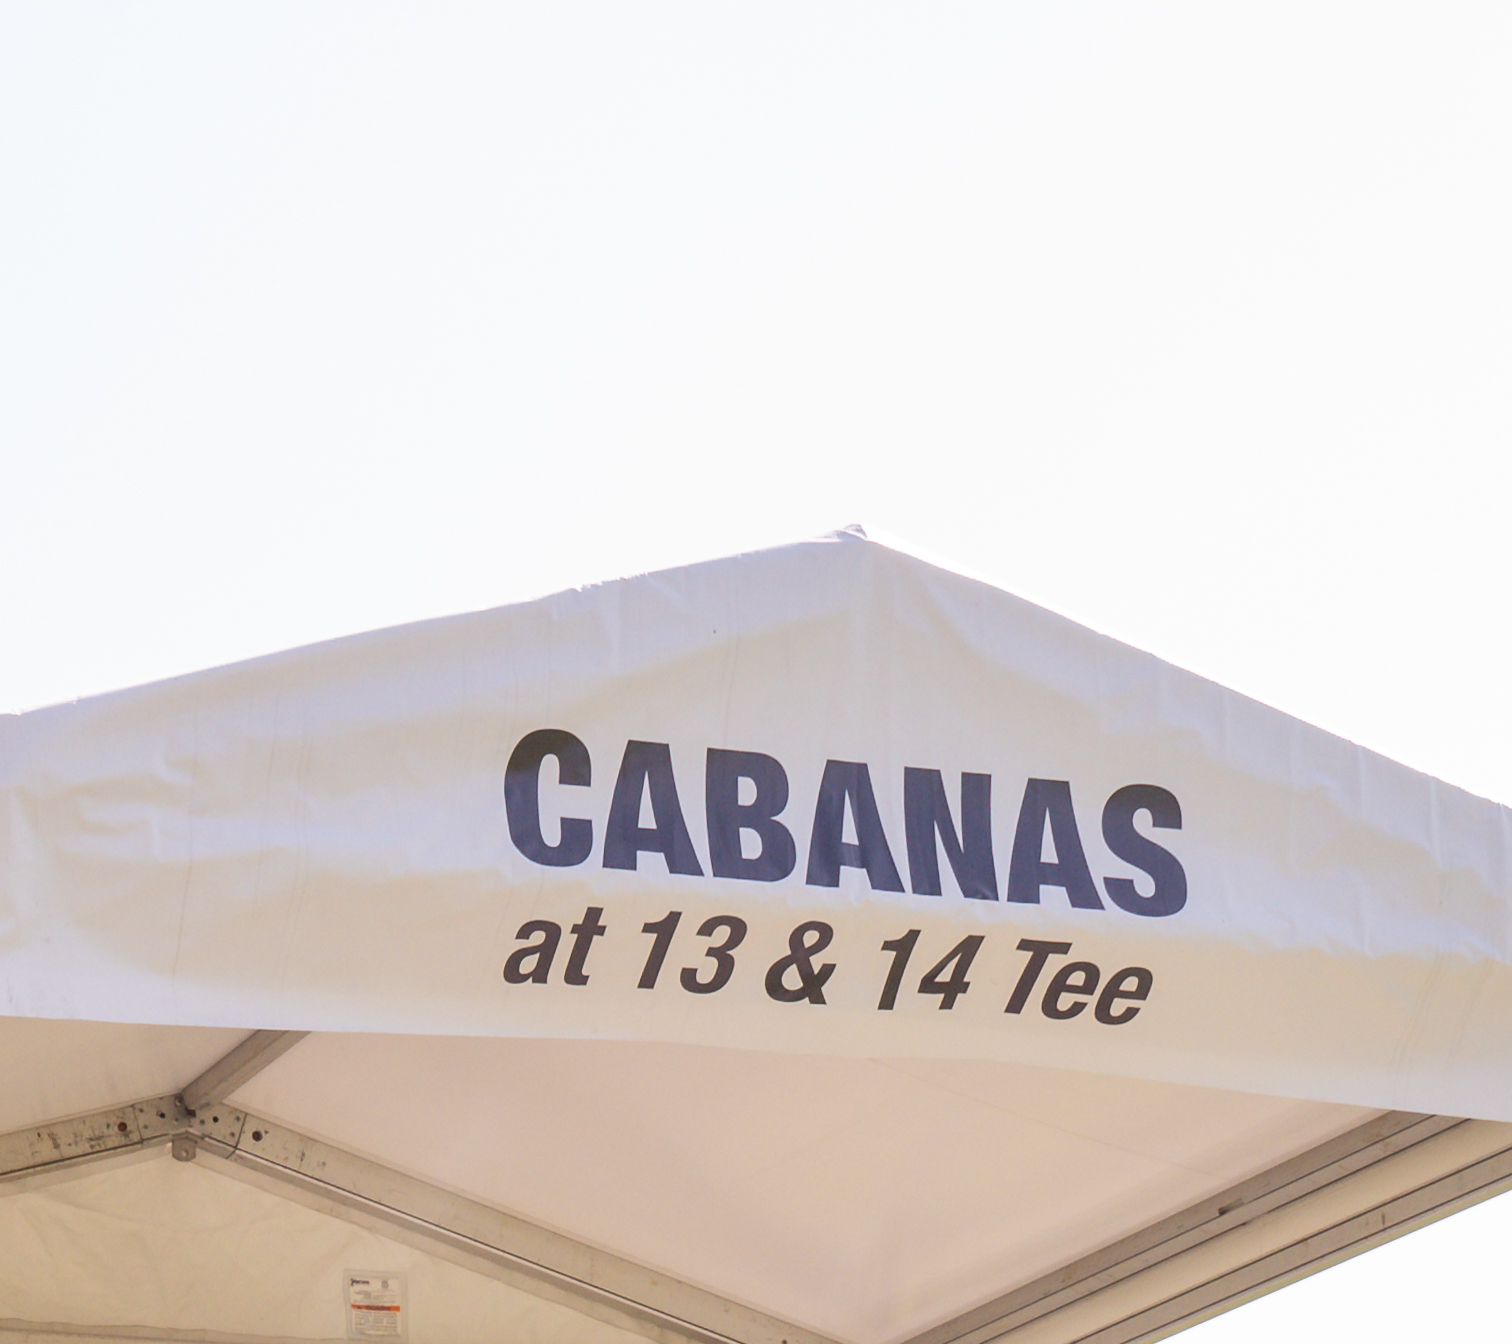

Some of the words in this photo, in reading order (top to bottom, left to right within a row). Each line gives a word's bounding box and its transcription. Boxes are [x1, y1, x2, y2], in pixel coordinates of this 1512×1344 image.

[504, 729, 1187, 919] CABANAS
[504, 907, 606, 985] at
[638, 911, 747, 994] 13
[765, 921, 836, 1004] &
[878, 929, 985, 1010] 14
[1004, 939, 1153, 1025] Tee
